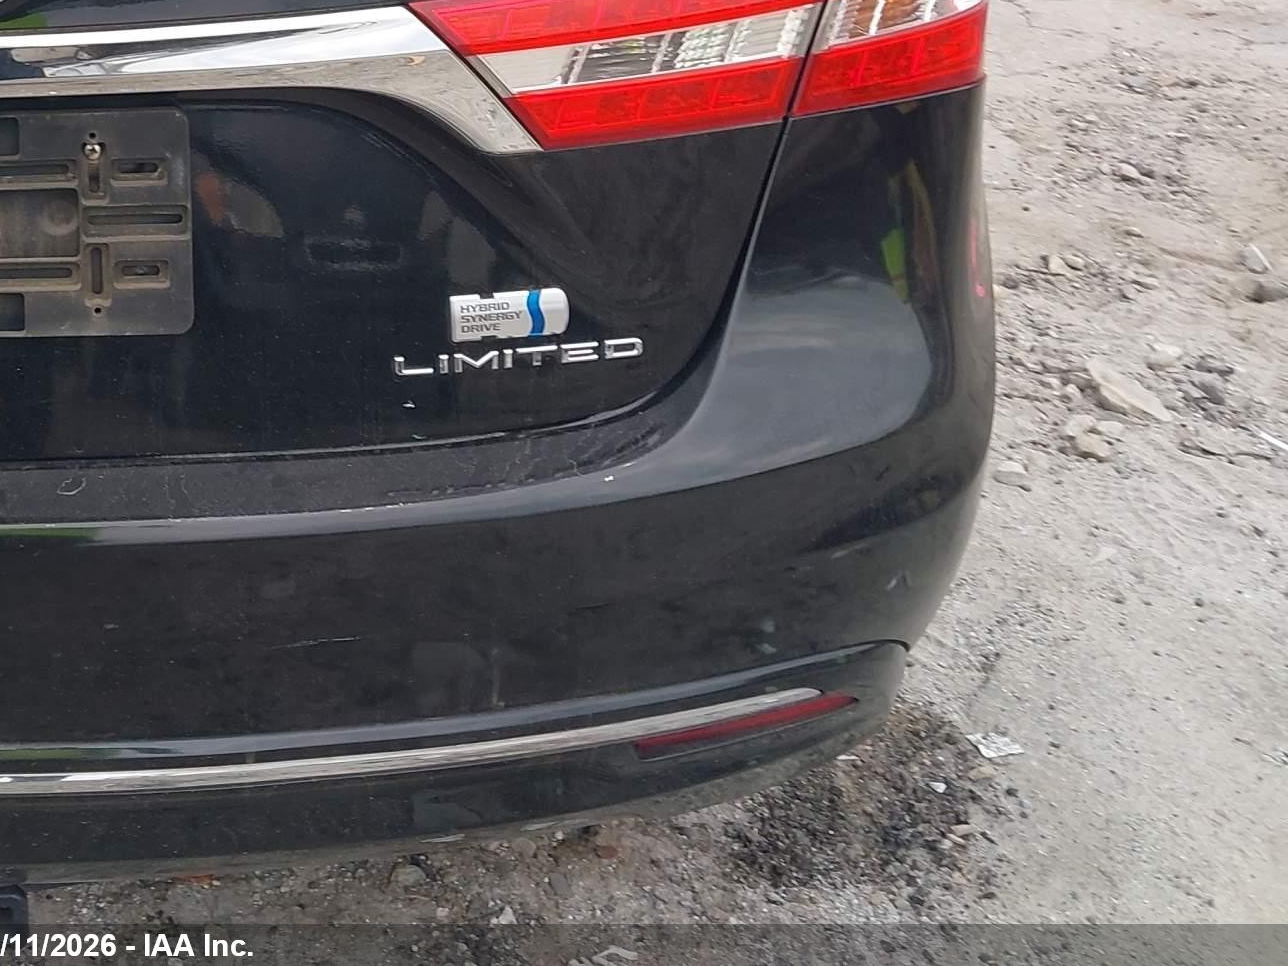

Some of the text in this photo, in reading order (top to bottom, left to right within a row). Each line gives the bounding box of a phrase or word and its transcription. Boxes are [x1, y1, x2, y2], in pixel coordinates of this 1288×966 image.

[460, 301, 511, 315] HYBRID
[460, 310, 523, 324] SYNERGY
[460, 322, 502, 334] DRIVE
[393, 336, 644, 377] LIMITED
